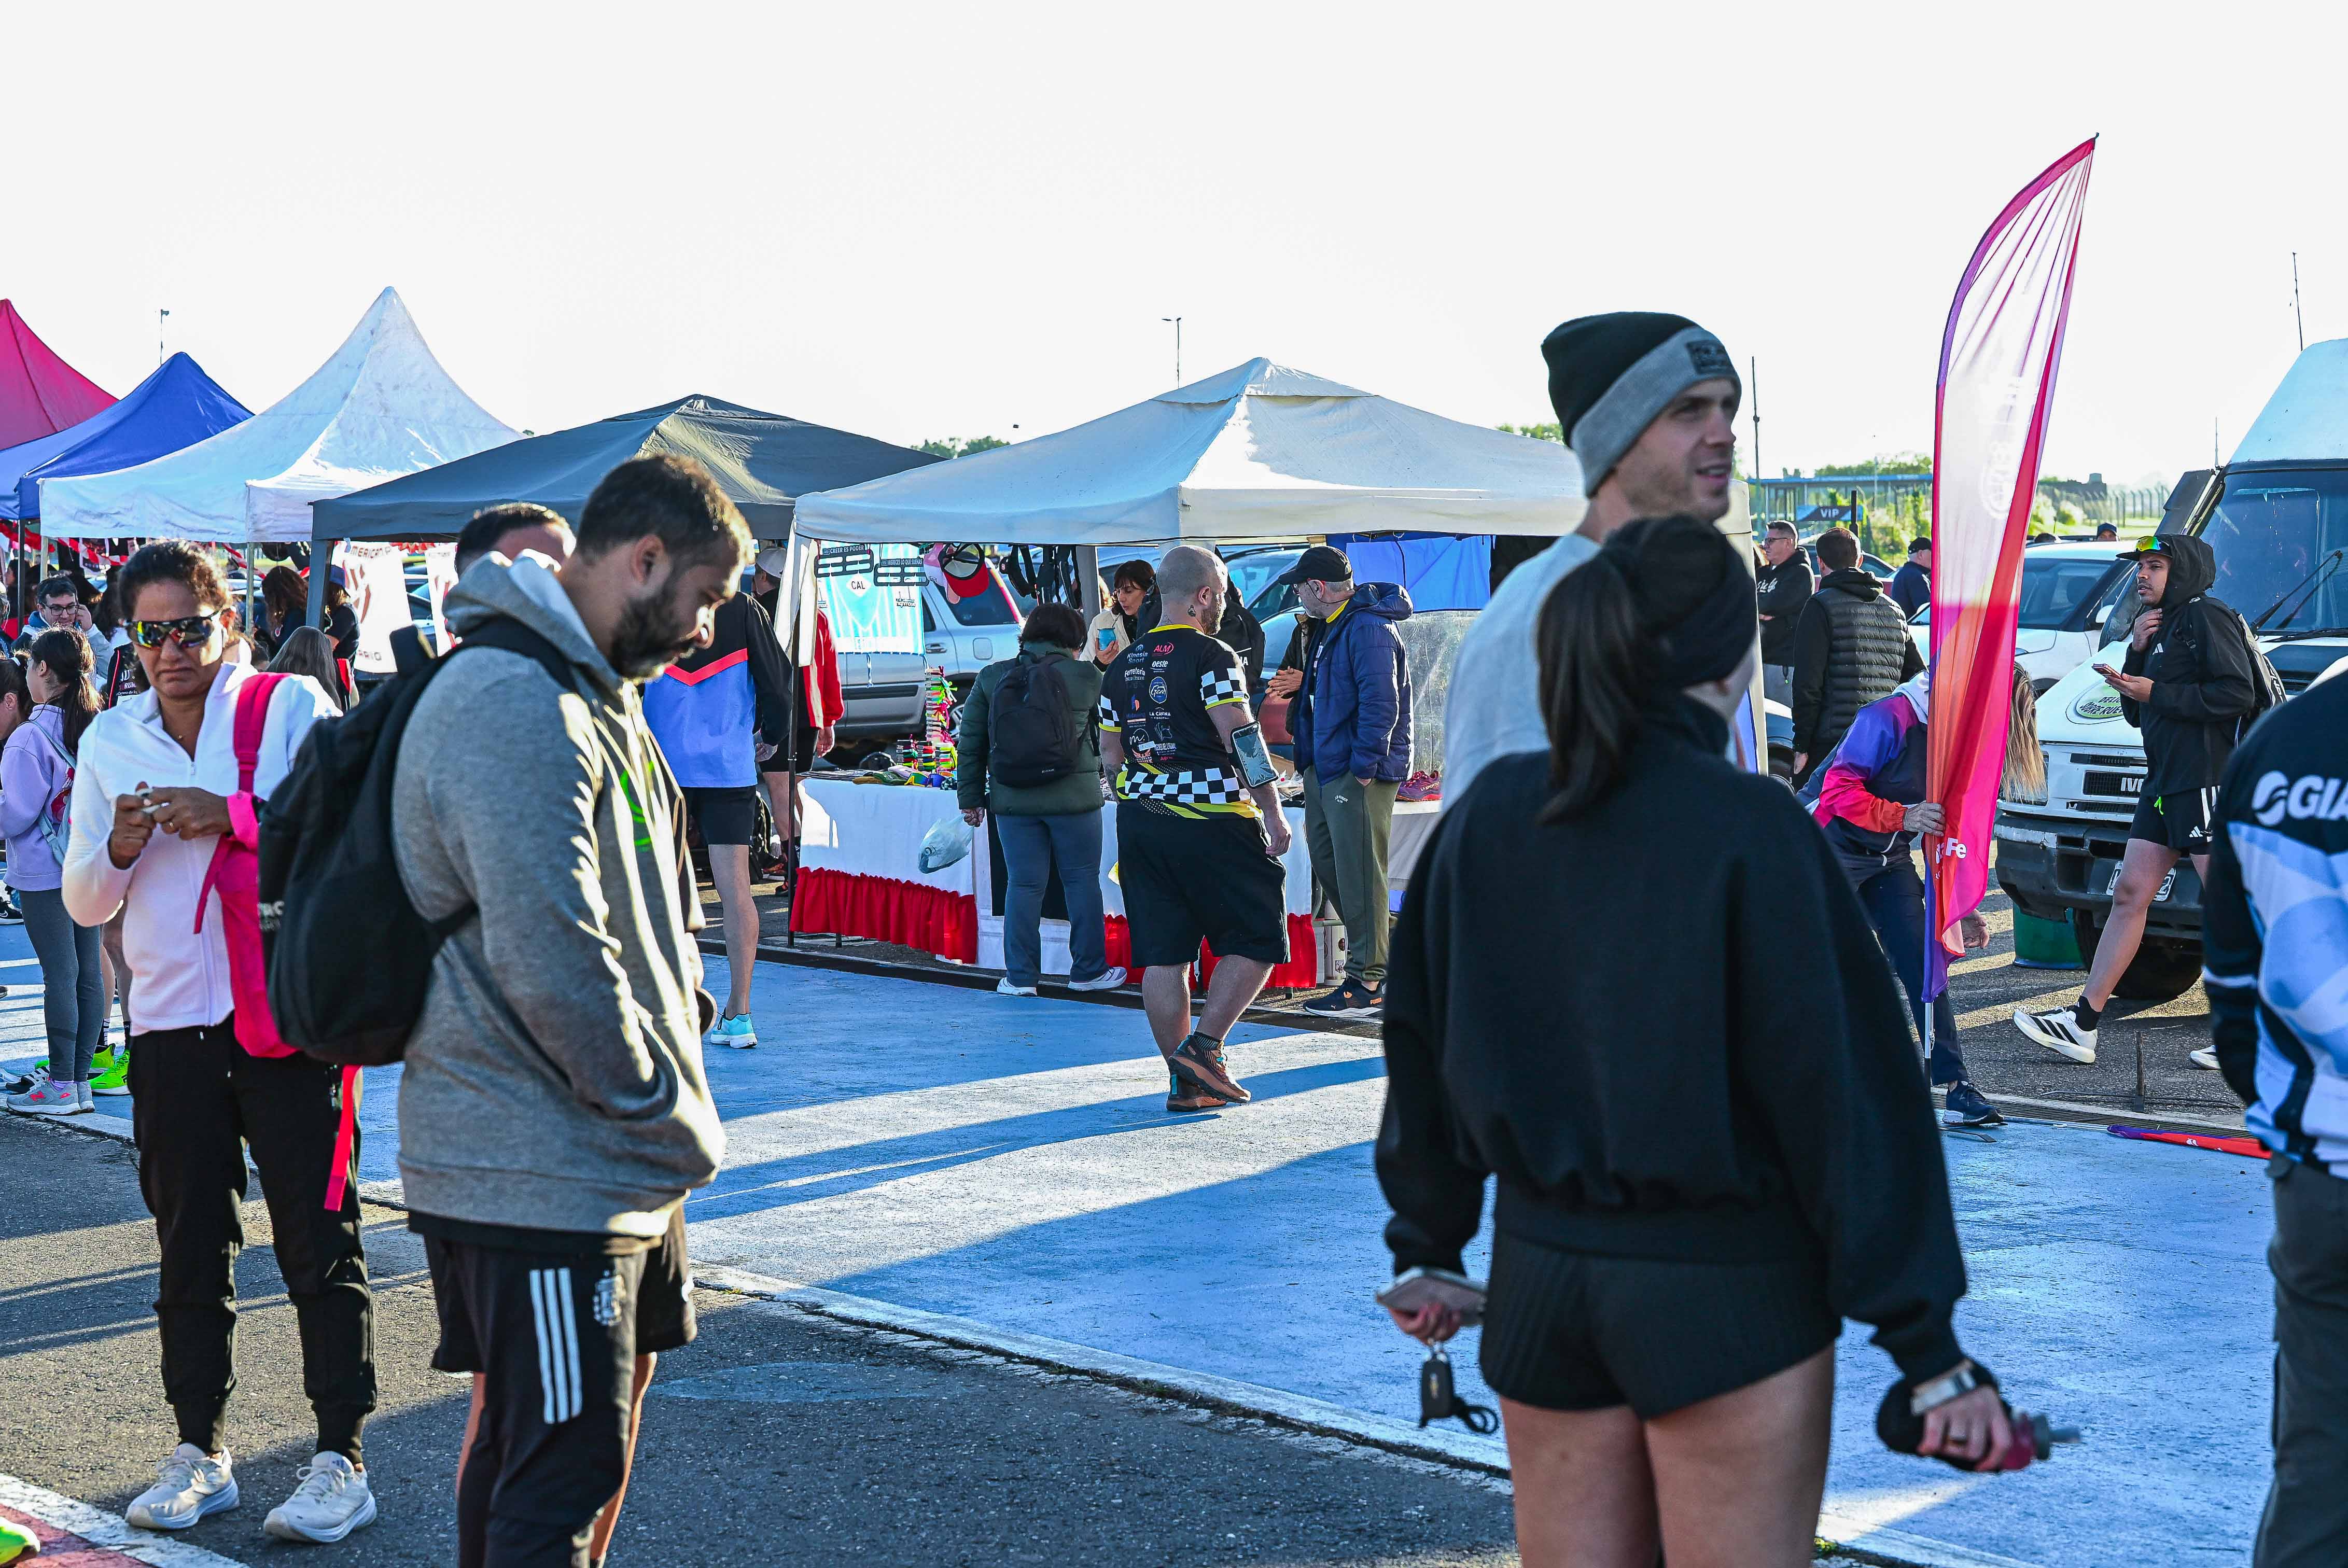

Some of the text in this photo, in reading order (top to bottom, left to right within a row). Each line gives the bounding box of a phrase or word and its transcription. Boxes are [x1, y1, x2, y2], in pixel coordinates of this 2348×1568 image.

[1820, 508, 1840, 518] VIP
[851, 581, 865, 590] CAL
[1945, 837, 1967, 859] Fe
